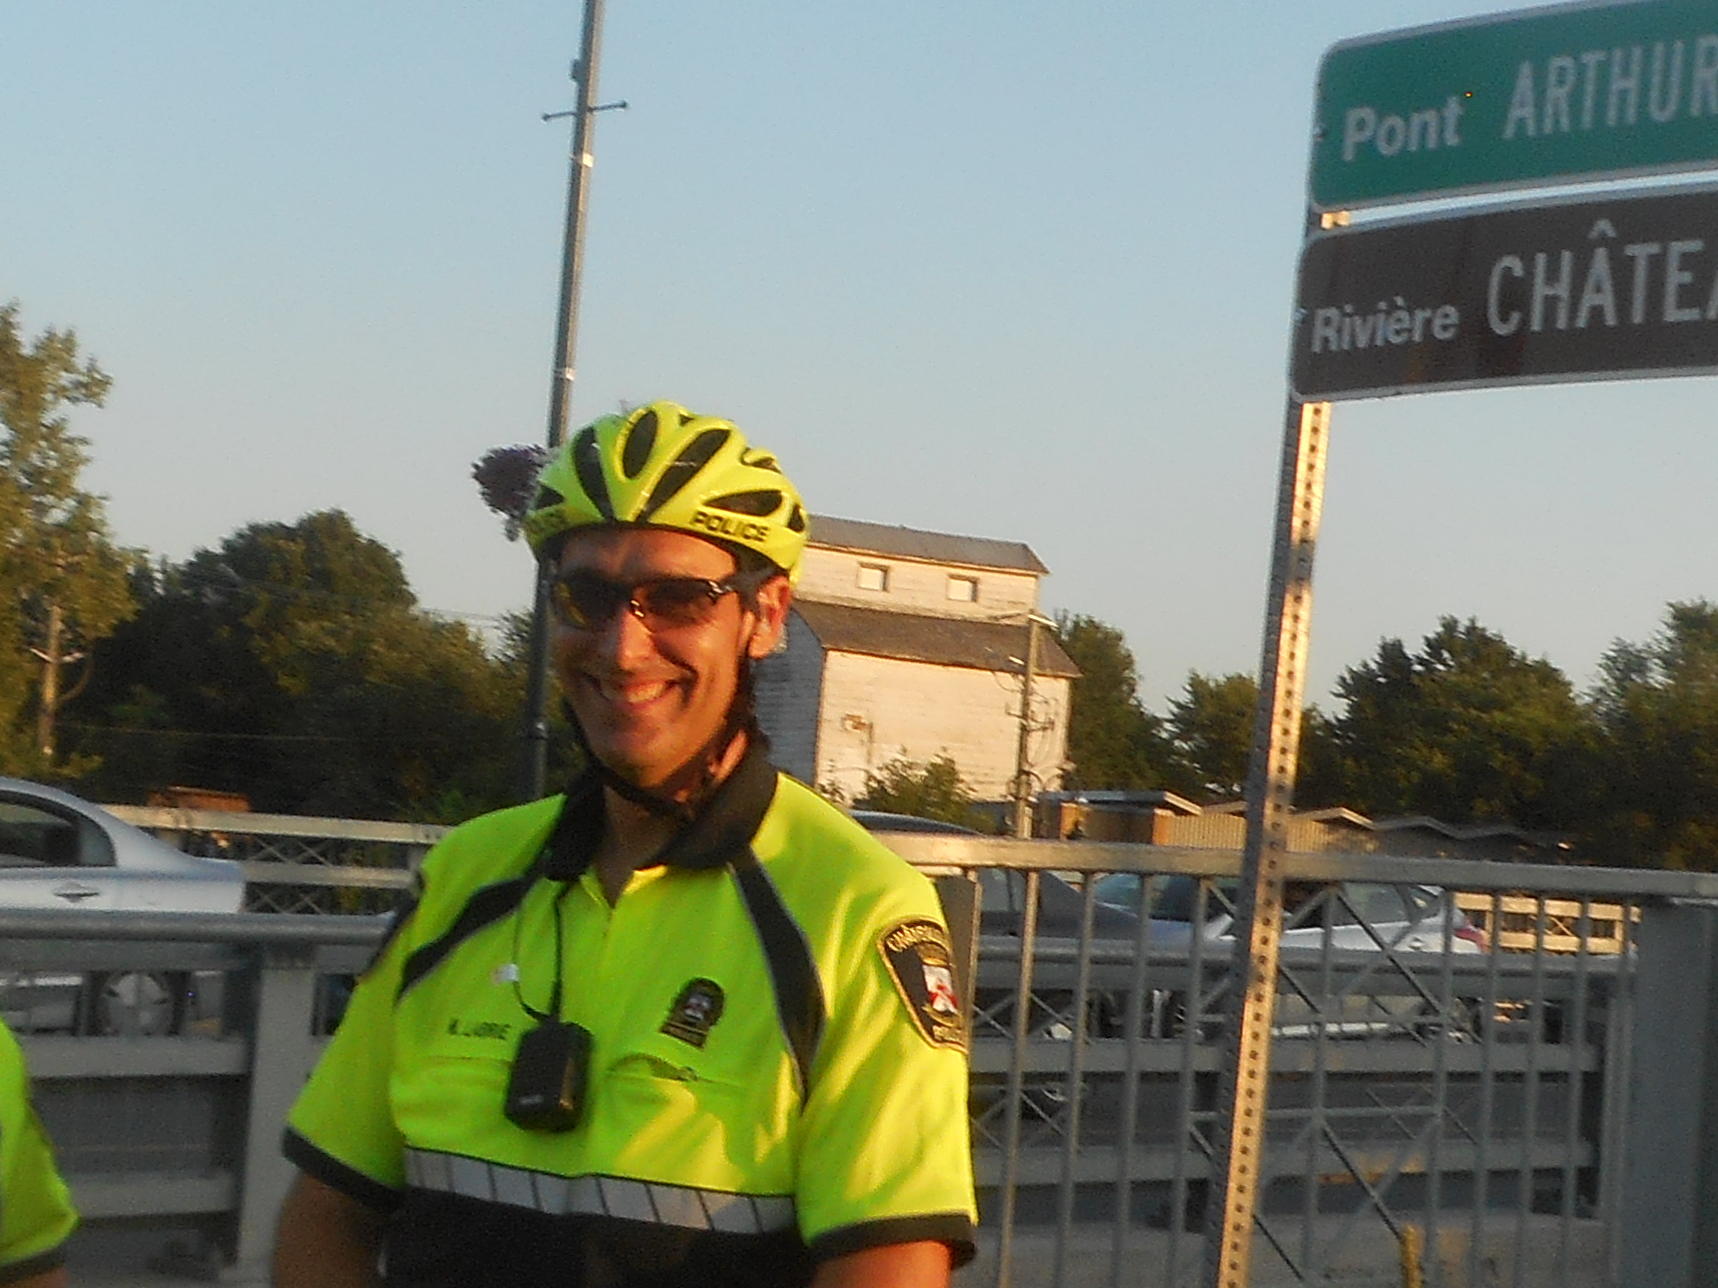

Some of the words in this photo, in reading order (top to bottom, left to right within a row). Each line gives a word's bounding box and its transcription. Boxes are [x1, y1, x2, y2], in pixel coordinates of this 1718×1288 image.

[1341, 97, 1463, 162] Pont
[1310, 296, 1460, 355] Rivière
[690, 510, 771, 544] POLICE
